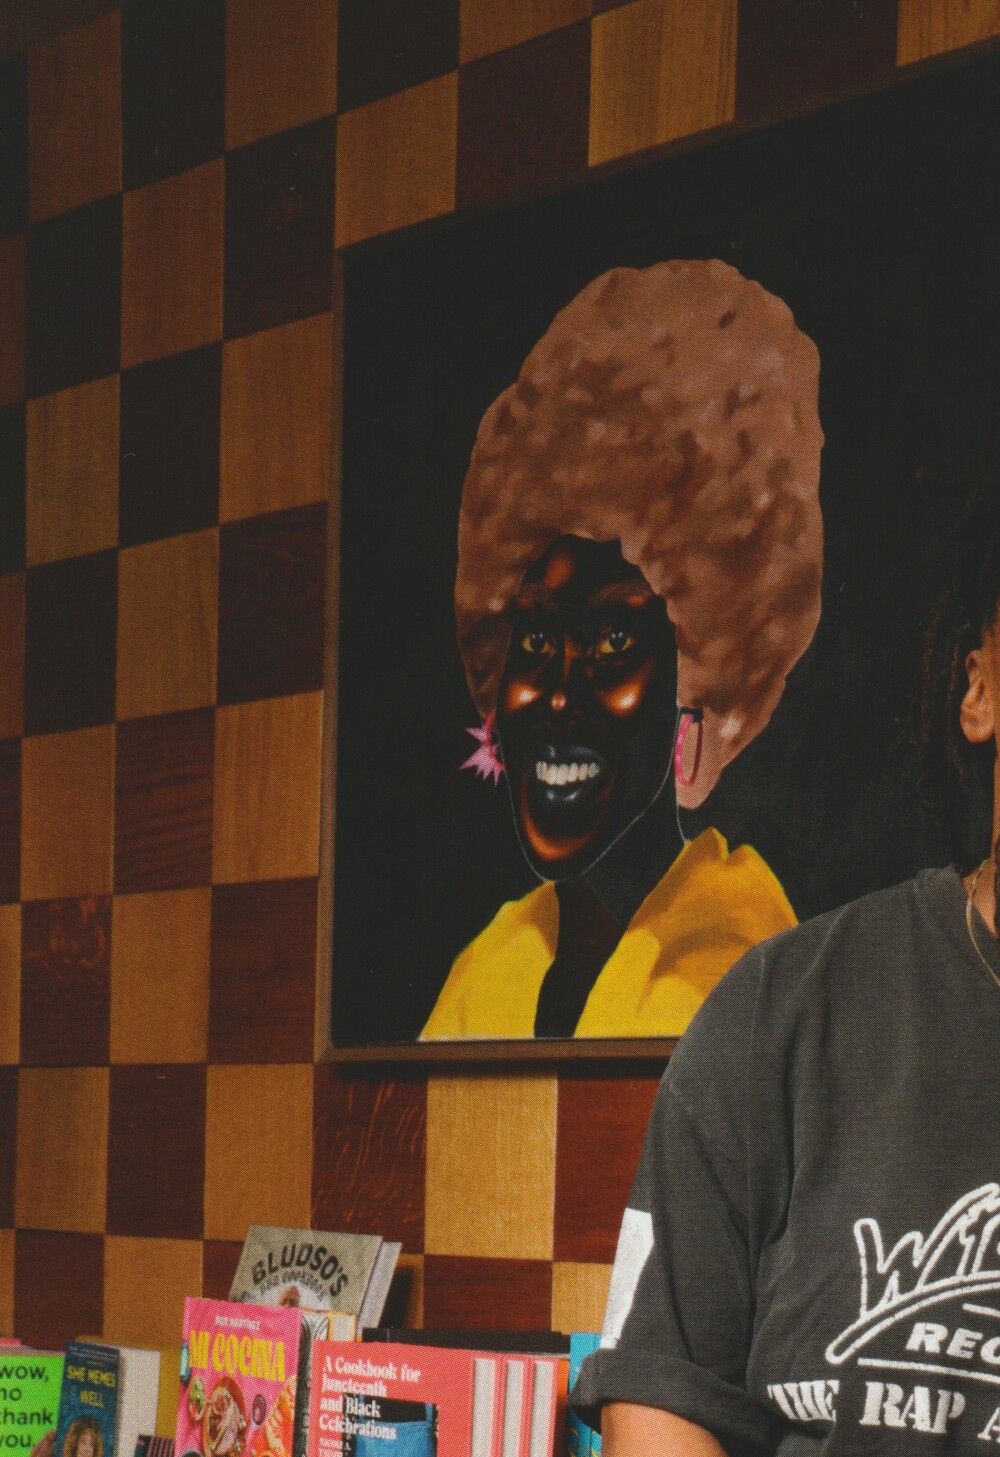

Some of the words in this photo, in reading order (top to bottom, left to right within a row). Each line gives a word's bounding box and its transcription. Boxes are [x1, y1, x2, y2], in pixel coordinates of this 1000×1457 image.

[252, 1242, 349, 1297] BLUDSO'S
[189, 1330, 210, 1369] MI
[212, 1332, 286, 1382] COCINA
[322, 1354, 333, 1374] A
[335, 1356, 397, 1380] Cookbook
[400, 1363, 421, 1383] for
[0, 1365, 49, 1383] wow,
[67, 1365, 86, 1382] SHE
[88, 1369, 116, 1388] MEMES
[321, 1373, 387, 1398] Juneteenth
[79, 1390, 104, 1408] WELL
[319, 1396, 344, 1412] and
[345, 1397, 381, 1418] Black
[767, 1379, 840, 1422] THE
[858, 1380, 965, 1434] RAP
[0, 1407, 53, 1425] hank
[319, 1414, 397, 1440] Celebrations
